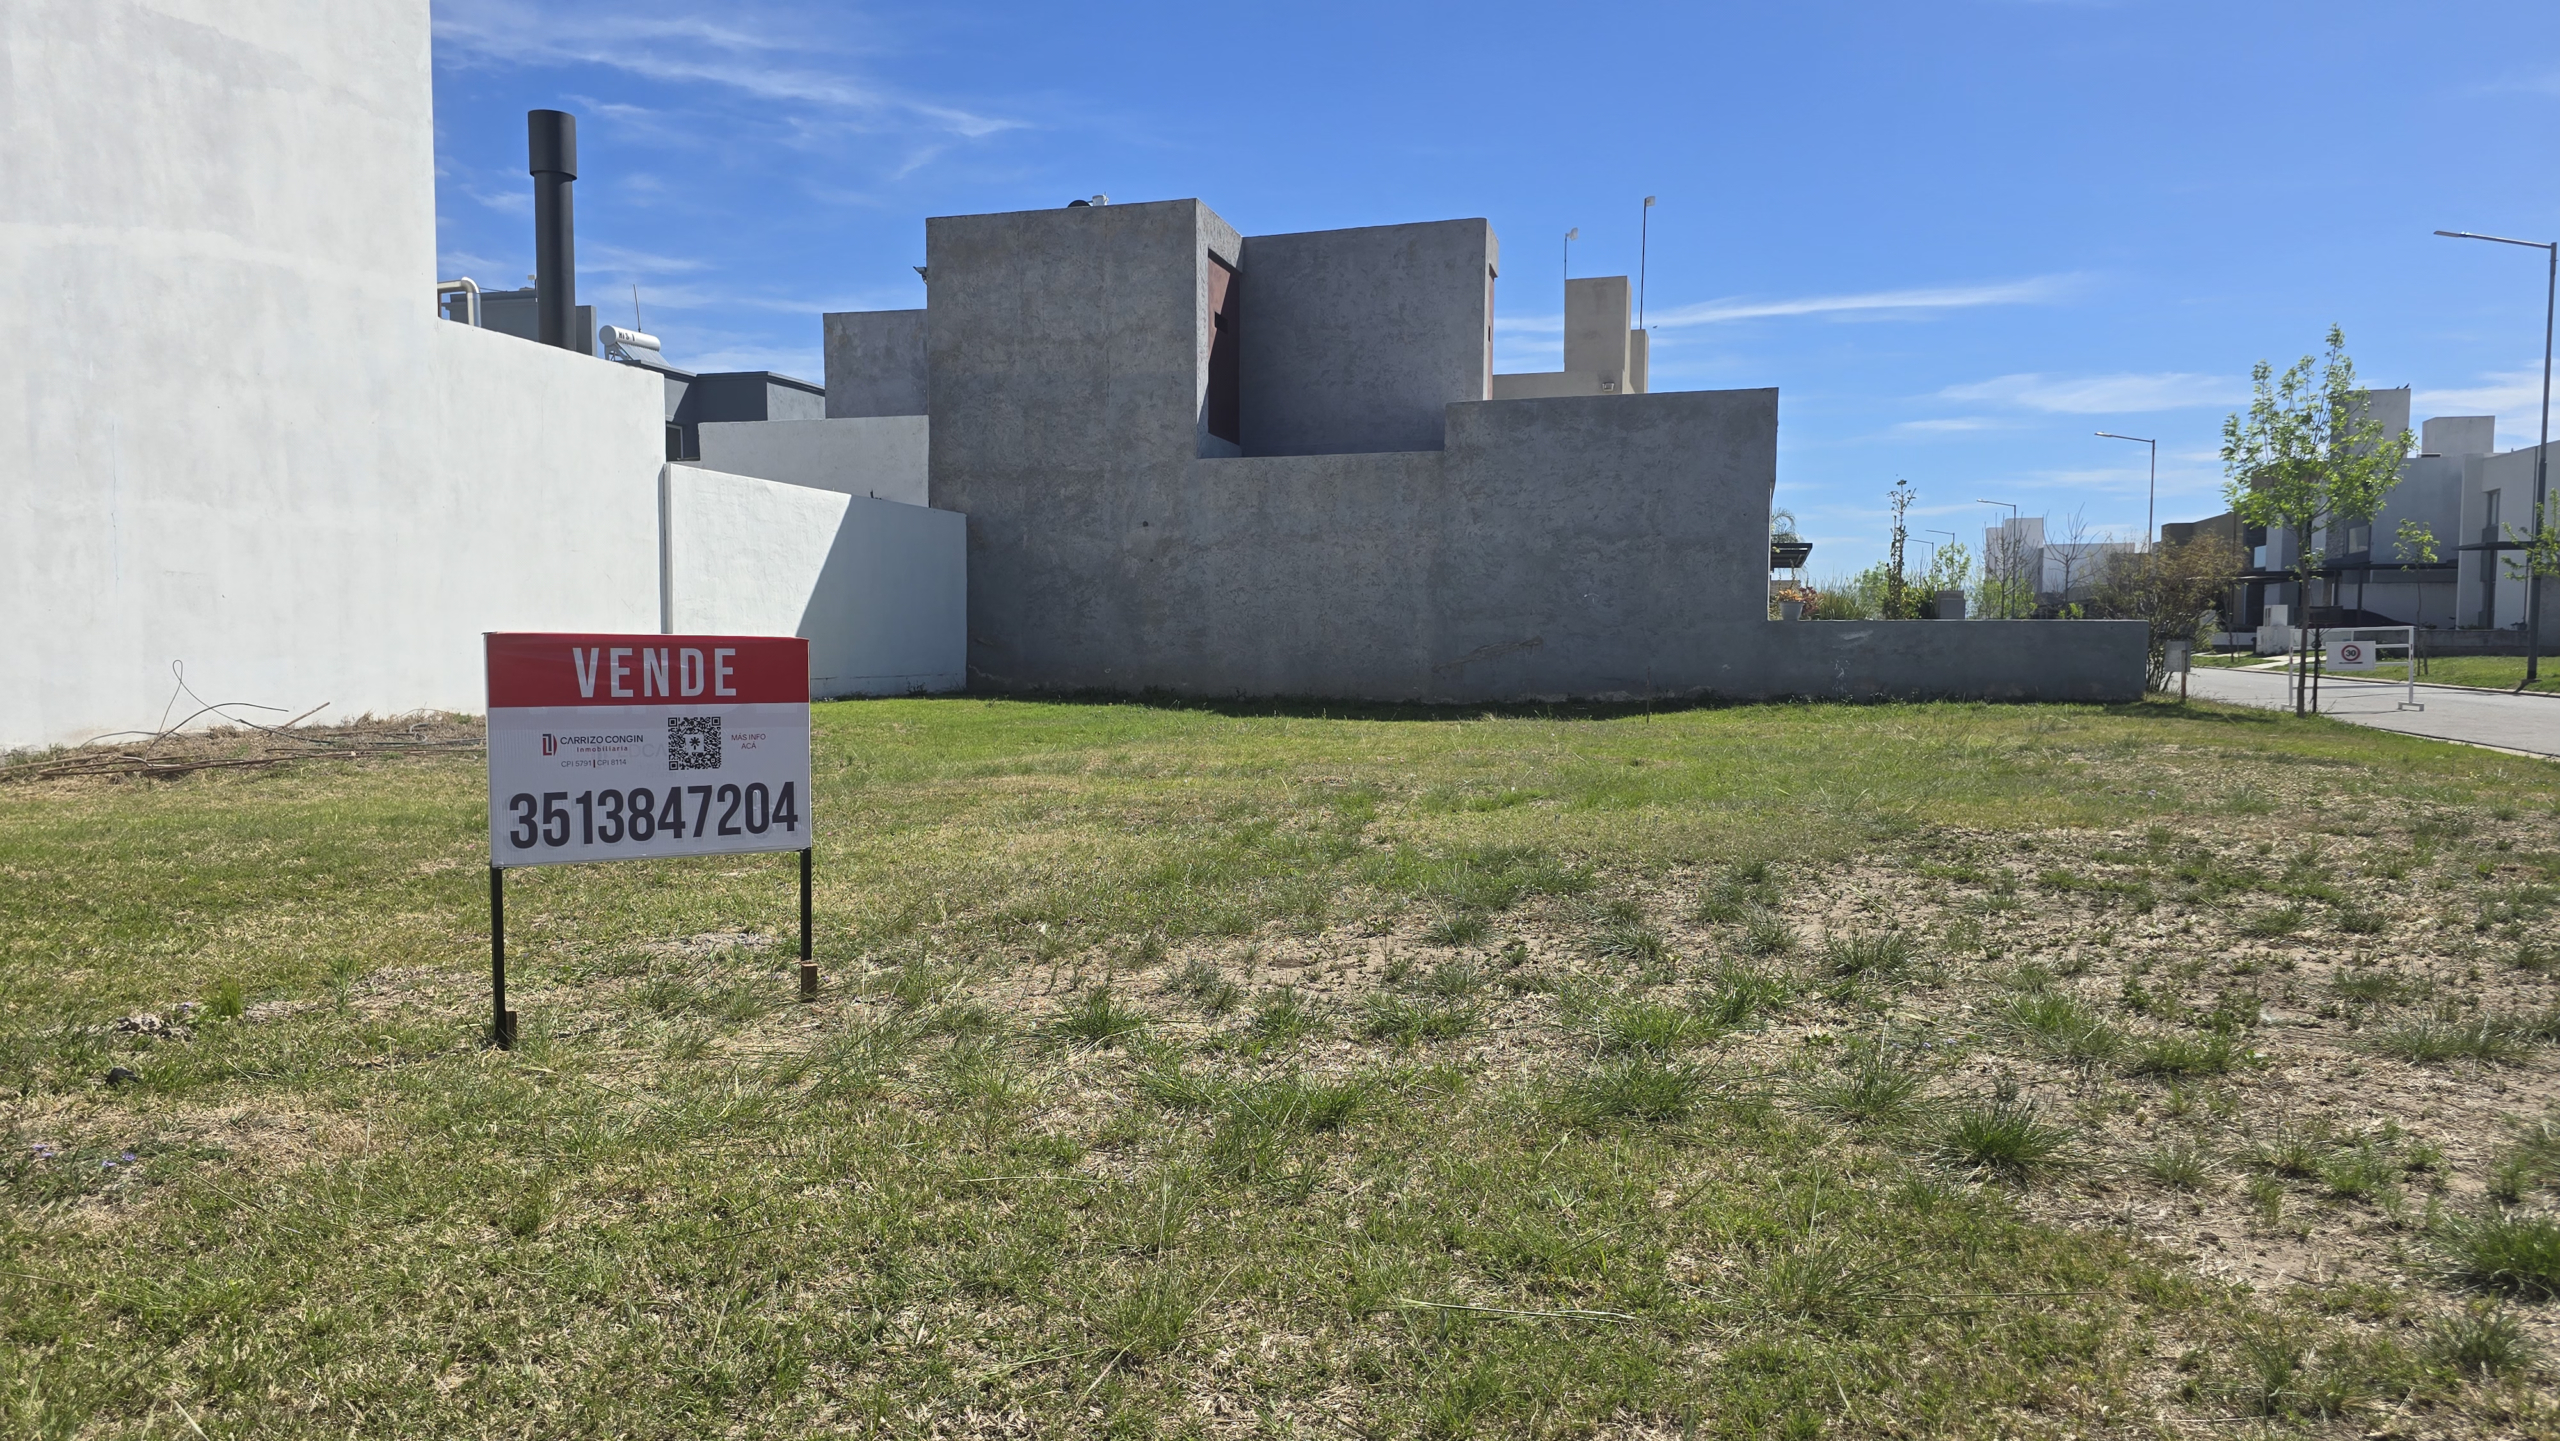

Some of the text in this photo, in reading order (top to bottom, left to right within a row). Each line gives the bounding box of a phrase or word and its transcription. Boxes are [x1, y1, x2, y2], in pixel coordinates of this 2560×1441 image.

[2345, 649, 2357, 657] 30
[572, 647, 737, 698] VENDE
[560, 734, 644, 745] CARRIZO CONGIN
[731, 732, 767, 741] MÁS INFO
[576, 745, 629, 753] Inmobiliaria
[741, 741, 757, 749] ACÁ
[560, 760, 574, 768] CPI
[610, 758, 627, 766] 8114
[509, 781, 799, 849] 3513847204
